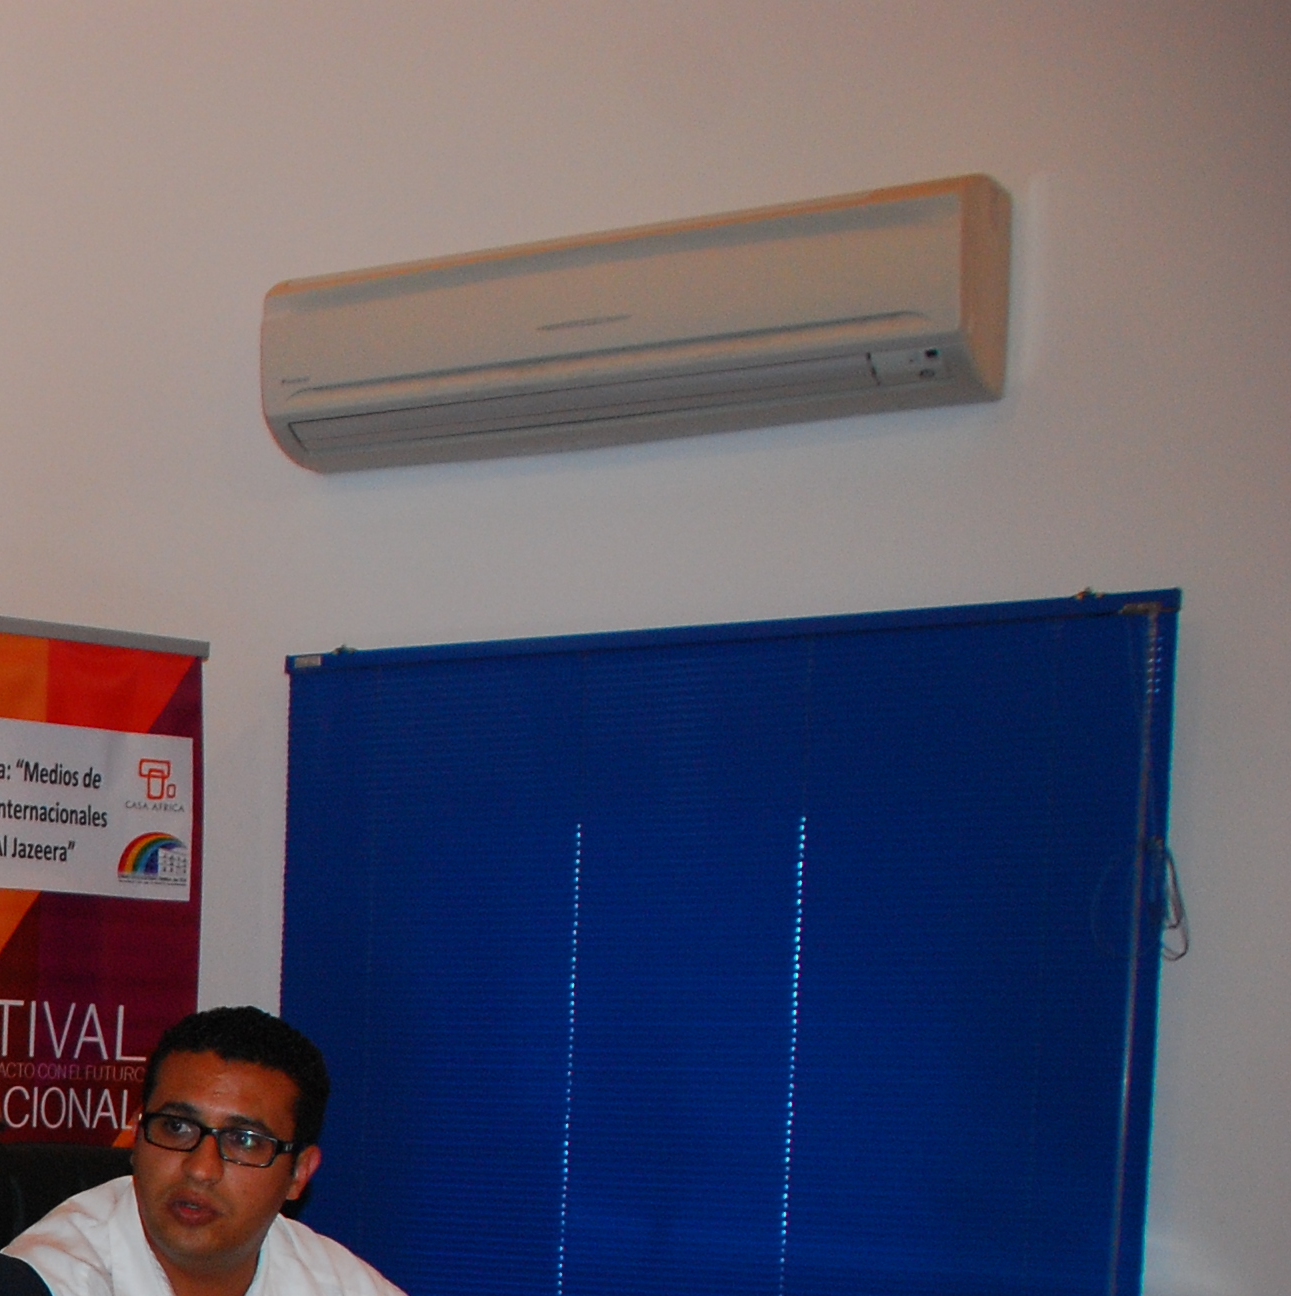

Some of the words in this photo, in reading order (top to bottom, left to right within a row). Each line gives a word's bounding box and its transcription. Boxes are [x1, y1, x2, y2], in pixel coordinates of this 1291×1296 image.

[16, 758, 79, 788] “Medios
[83, 766, 102, 789] de
[125, 800, 148, 810] CASA
[11, 837, 75, 862] Jazeera”
[38, 1062, 67, 1080] CON
[69, 1064, 81, 1081] EL
